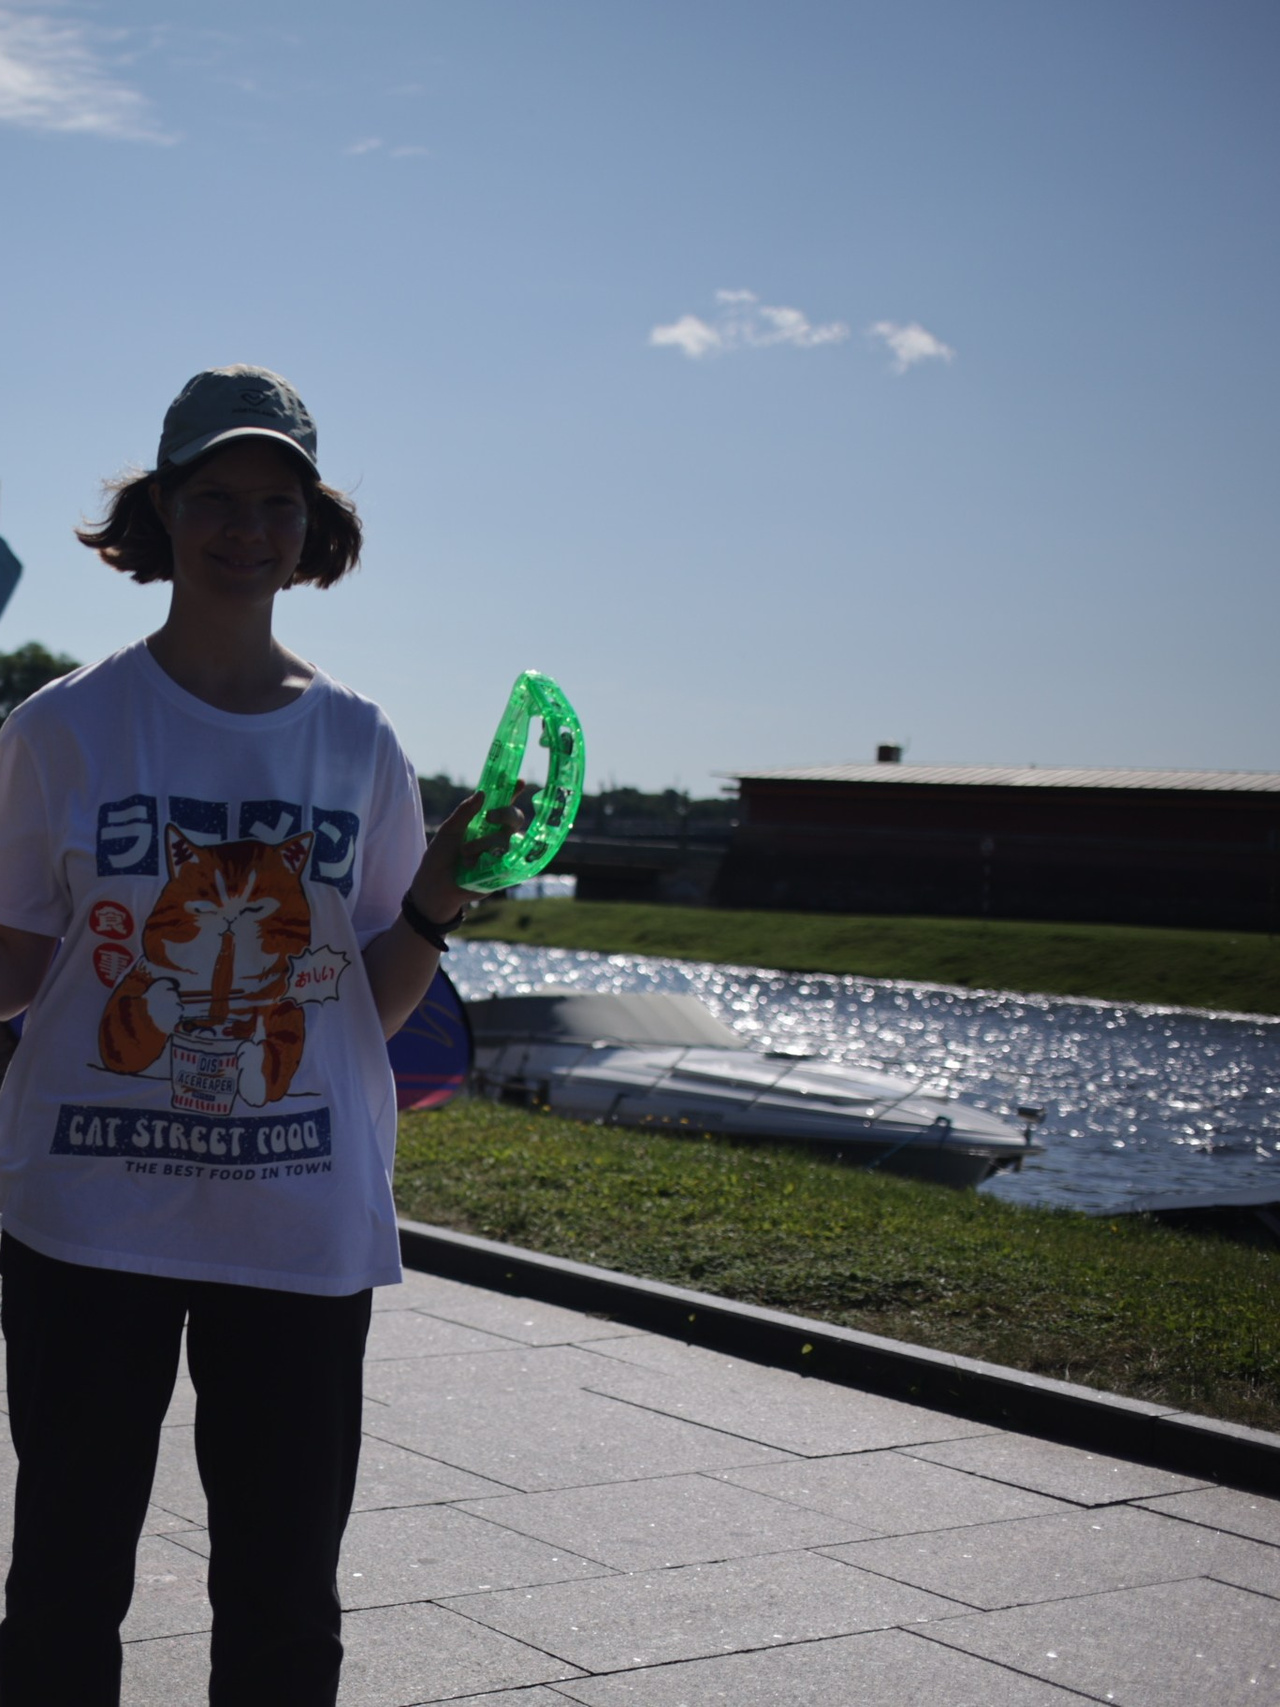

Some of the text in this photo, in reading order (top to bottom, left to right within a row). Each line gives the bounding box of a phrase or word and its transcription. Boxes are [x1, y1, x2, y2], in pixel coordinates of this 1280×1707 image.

[70, 1115, 320, 1157] CAT STREET FOOD
[125, 1160, 332, 1180] THE BEST FOOD IN TOWN
